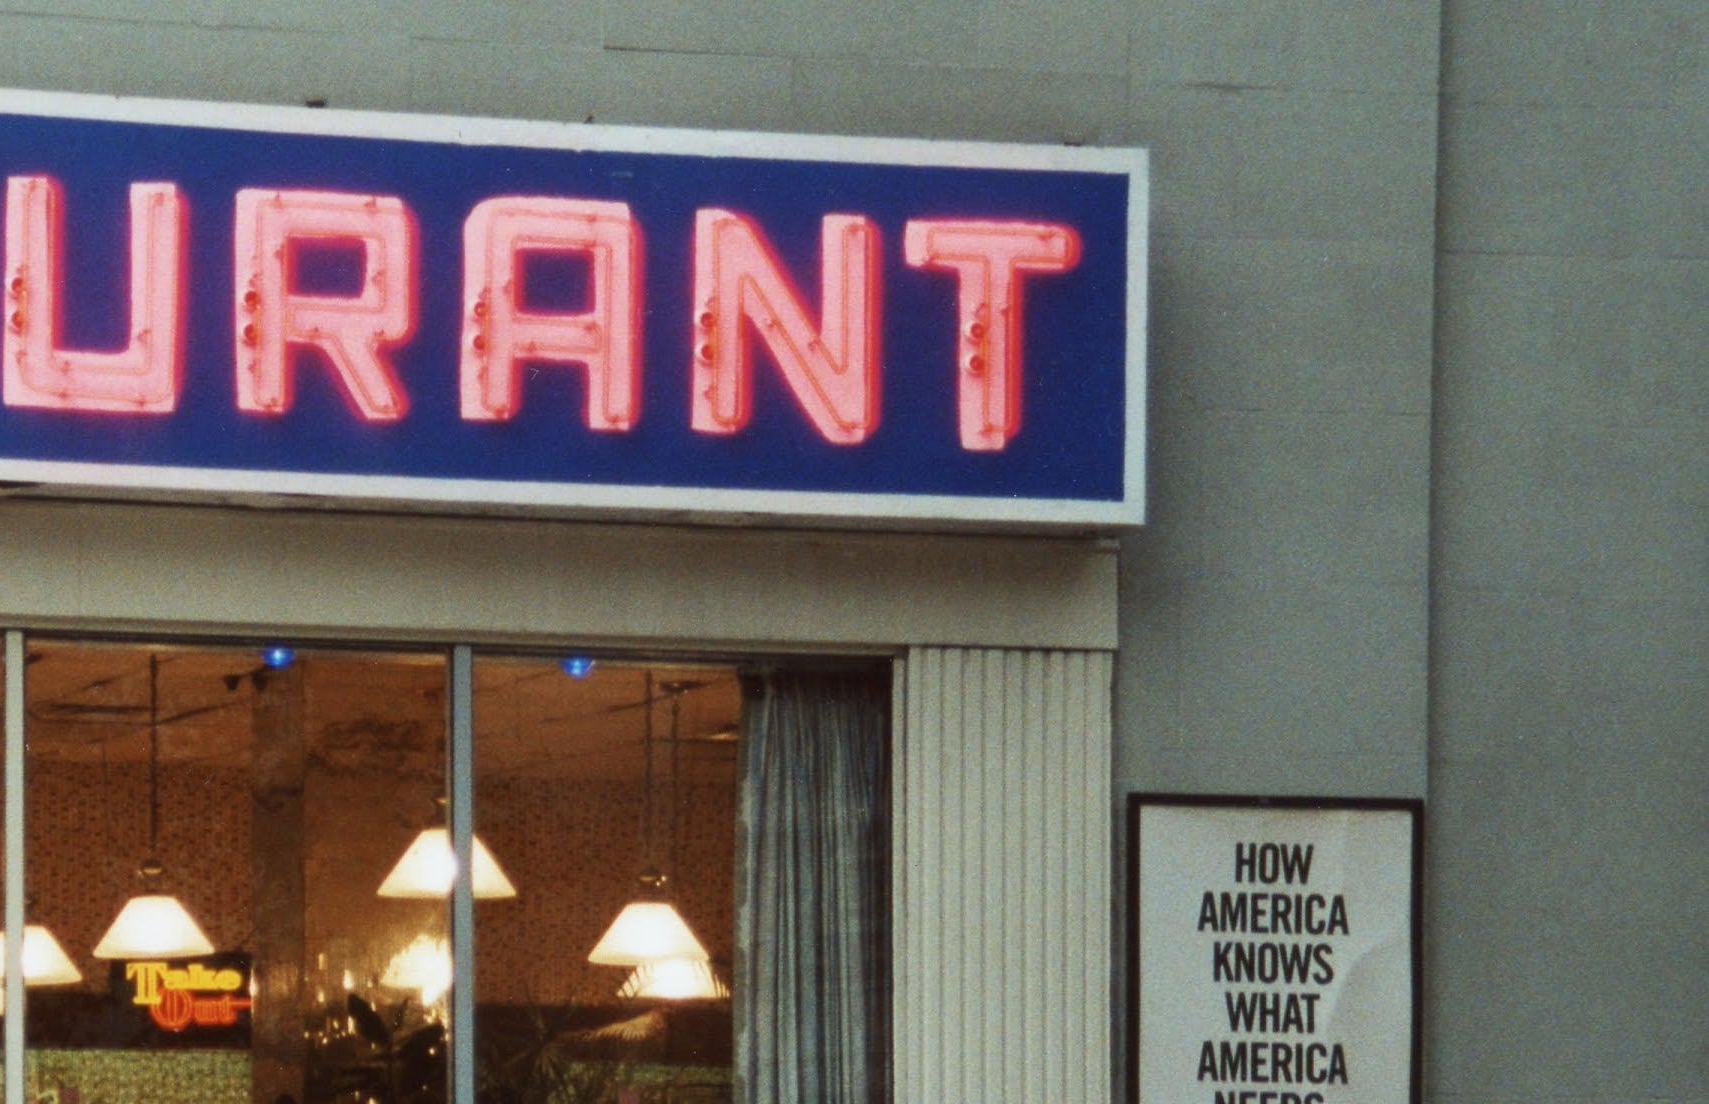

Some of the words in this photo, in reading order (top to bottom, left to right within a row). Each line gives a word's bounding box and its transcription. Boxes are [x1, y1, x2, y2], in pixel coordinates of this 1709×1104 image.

[1235, 842, 1314, 885] HOW
[1197, 890, 1349, 935] AMERICA
[126, 962, 242, 1004] Take
[1212, 942, 1334, 985] KNOWS
[151, 987, 250, 1029] Out
[1225, 993, 1320, 1034] WHAT
[1197, 1040, 1348, 1085] AMERICA
